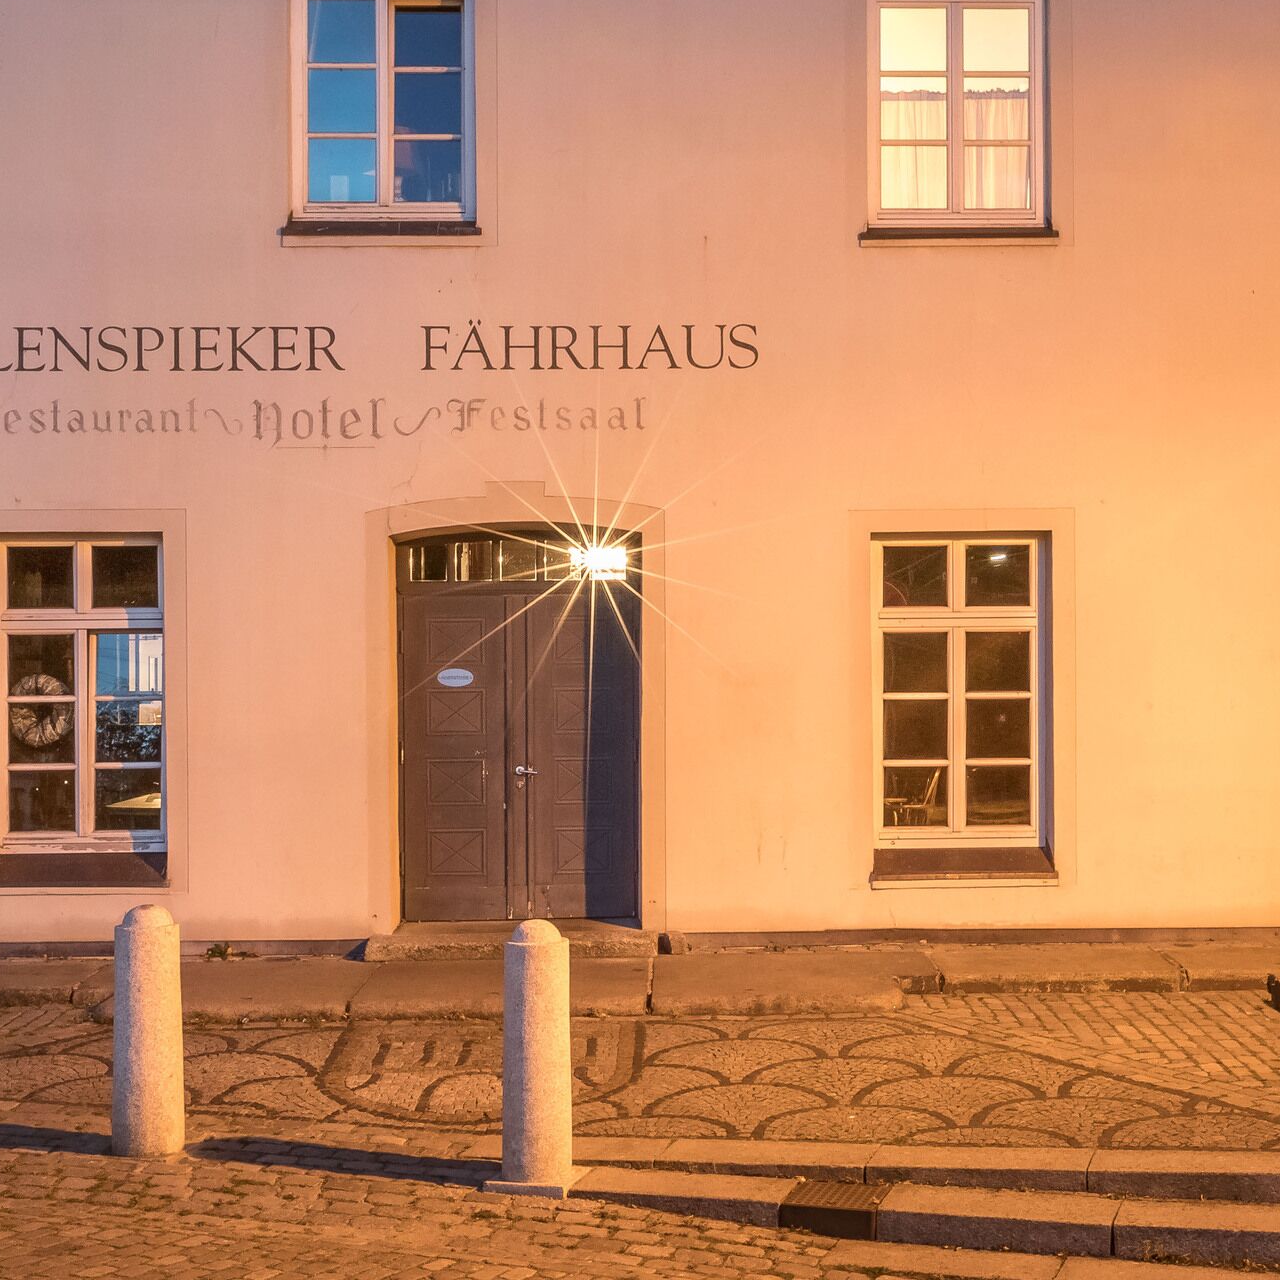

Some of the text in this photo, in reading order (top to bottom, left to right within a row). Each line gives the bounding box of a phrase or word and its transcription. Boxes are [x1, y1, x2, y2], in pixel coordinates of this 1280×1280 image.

[420, 319, 759, 370] FÄHRHAUS
[250, 396, 387, 449] Hotel
[446, 396, 647, 437] Festsaal
